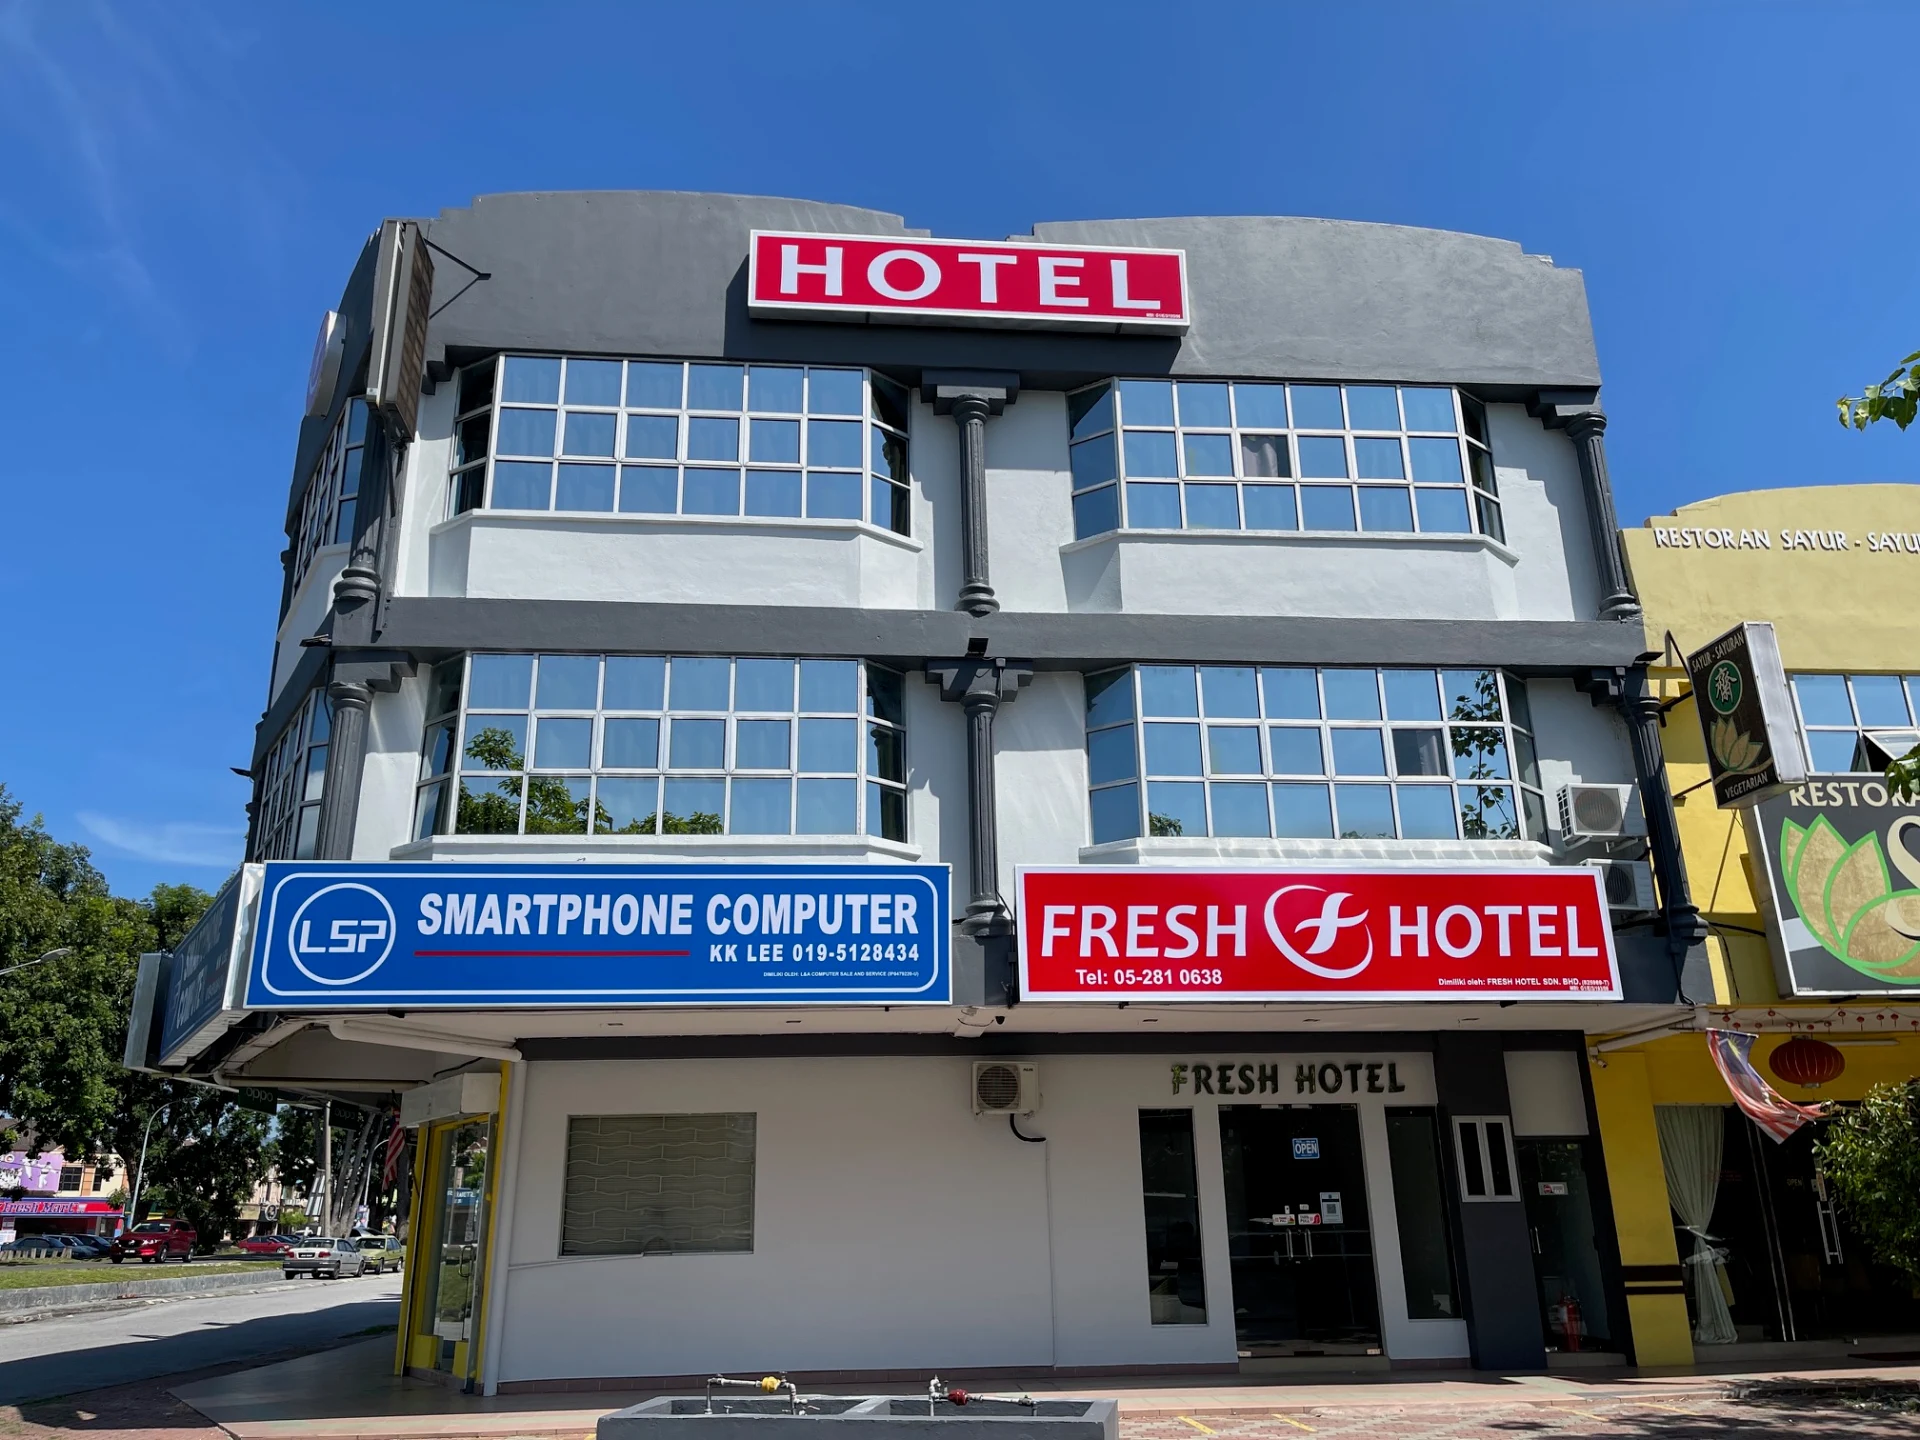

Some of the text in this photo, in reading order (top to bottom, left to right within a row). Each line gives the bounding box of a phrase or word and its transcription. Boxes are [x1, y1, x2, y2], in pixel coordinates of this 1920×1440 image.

[780, 244, 1161, 310] HOTEL
[1655, 527, 1771, 549] RESTORAN
[1780, 529, 1848, 551] SAYUR
[1691, 651, 1711, 674] SAYUR
[1714, 631, 1745, 660] SAYURAN
[1725, 772, 1768, 799] VEGETARIAN
[418, 893, 919, 936] SMARTPHONE COMPUTER
[299, 919, 387, 954] LSP
[1041, 904, 1599, 959] FRESH HOTEL
[710, 944, 919, 962] KK LEE 019-5128434
[1075, 968, 1223, 985] Tel: 05-281 0638
[1438, 978, 1466, 986] Dimiliki
[1467, 978, 1486, 986] oleh:
[1487, 978, 1513, 986] FRESH
[1515, 978, 1541, 986] HOTEL
[1543, 978, 1561, 986] SDN.
[1562, 978, 1581, 986] BHD.
[1171, 1062, 1406, 1096] FRESH HOTEL
[246, 1087, 273, 1102] oppo
[1295, 1143, 1317, 1154] OPEN
[3, 1202, 76, 1214] Fresh Mart
